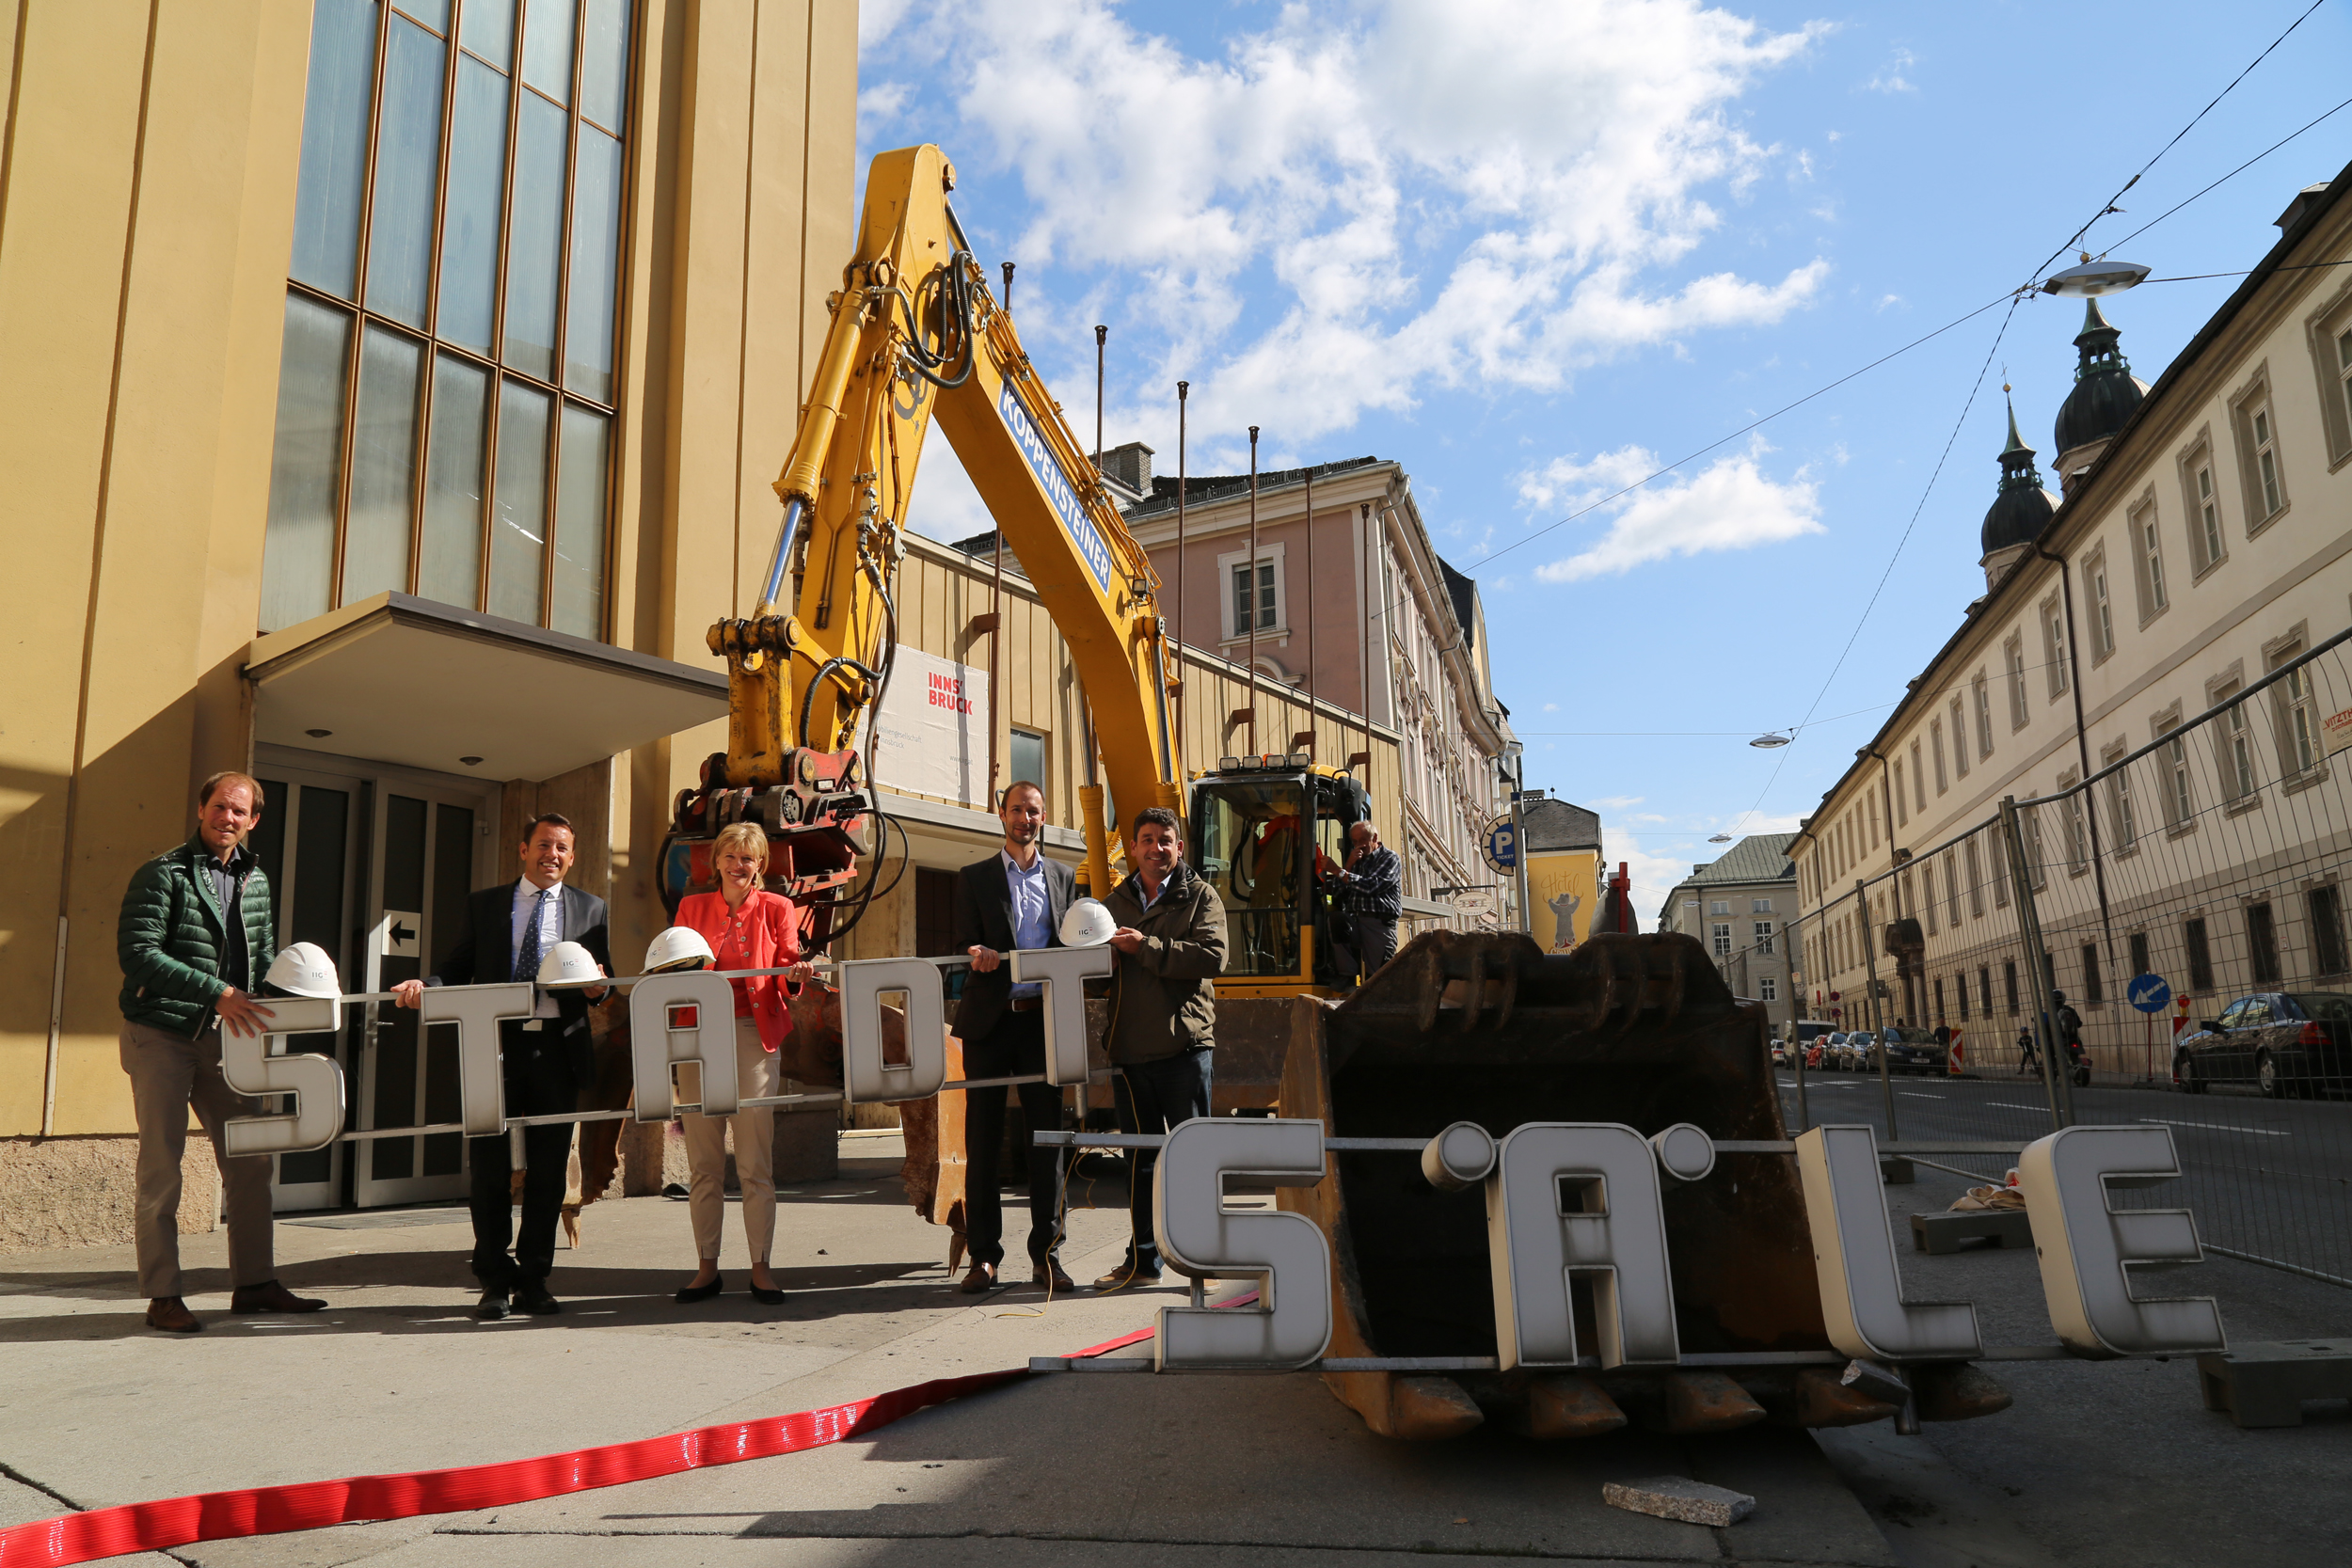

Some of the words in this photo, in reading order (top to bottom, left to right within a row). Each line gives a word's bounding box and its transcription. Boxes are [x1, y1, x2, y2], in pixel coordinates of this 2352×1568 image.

[1003, 390, 1109, 585] KOPPENSTEINER
[929, 689, 974, 716] BRUCK
[1495, 832, 1513, 854] P
[1540, 871, 1582, 900] Hotel
[221, 943, 1113, 1159] STADT
